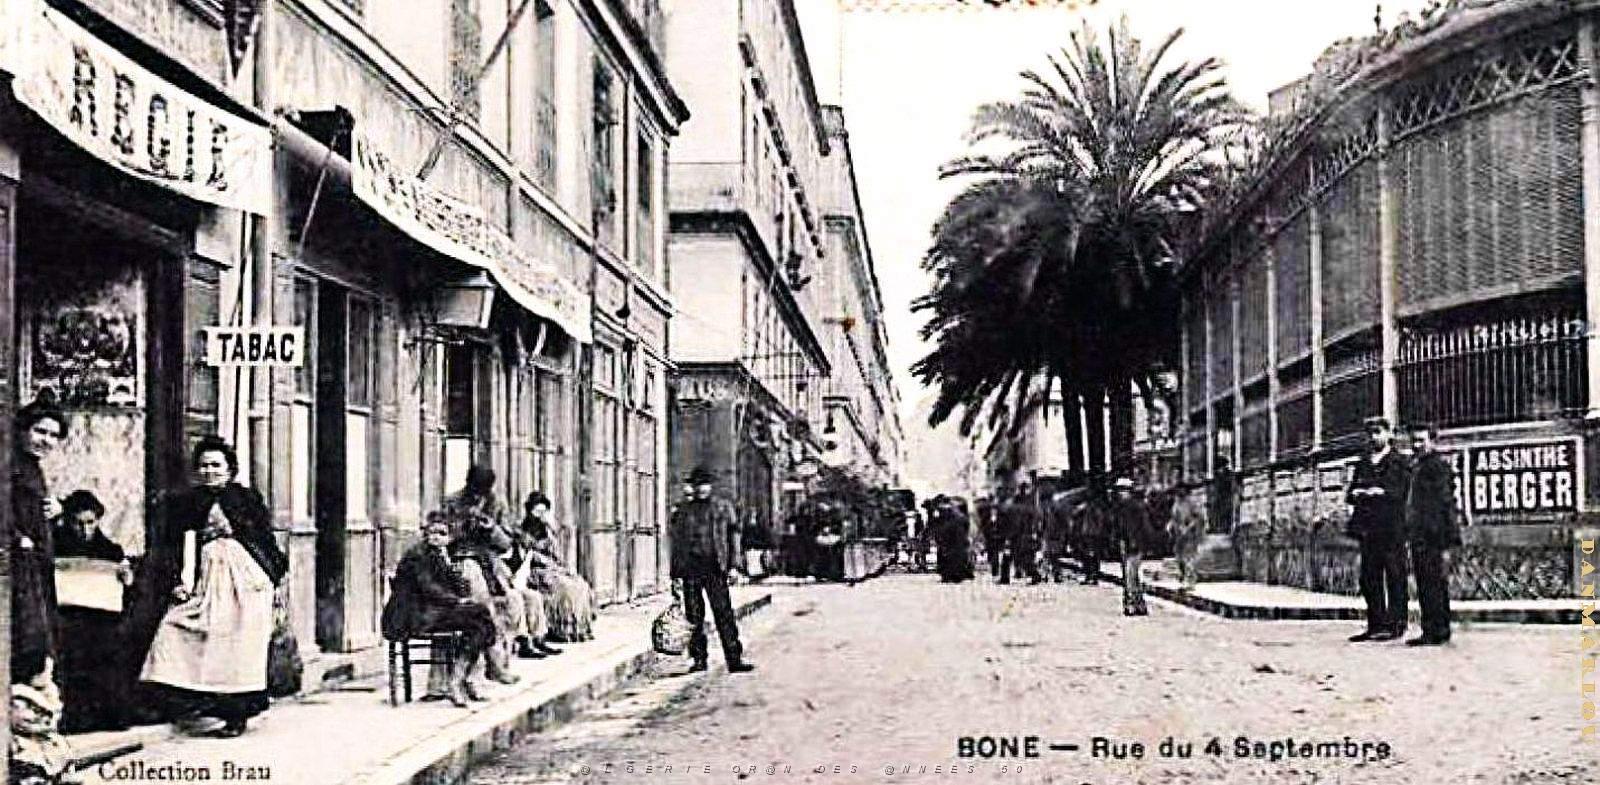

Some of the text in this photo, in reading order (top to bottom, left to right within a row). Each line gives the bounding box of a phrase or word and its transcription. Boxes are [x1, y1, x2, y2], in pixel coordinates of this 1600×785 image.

[217, 332, 296, 362] TABAC
[1476, 445, 1569, 471] ABSINTHE
[1475, 471, 1572, 510] BERGER
